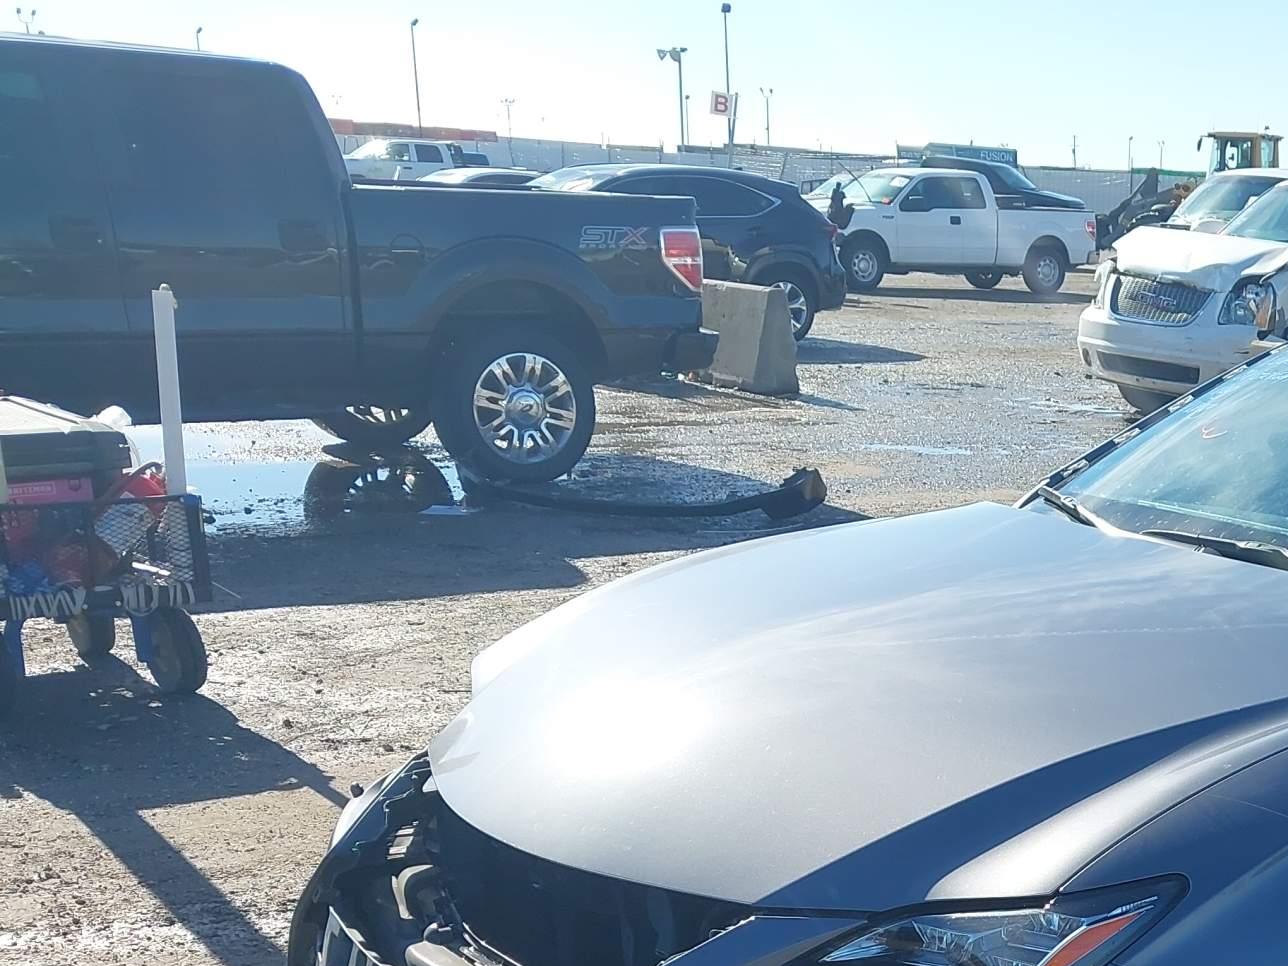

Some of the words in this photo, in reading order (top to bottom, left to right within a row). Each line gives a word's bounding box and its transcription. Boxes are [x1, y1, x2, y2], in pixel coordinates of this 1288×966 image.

[714, 94, 729, 113] B
[980, 150, 1014, 162] FUSION
[580, 225, 651, 244] STX
